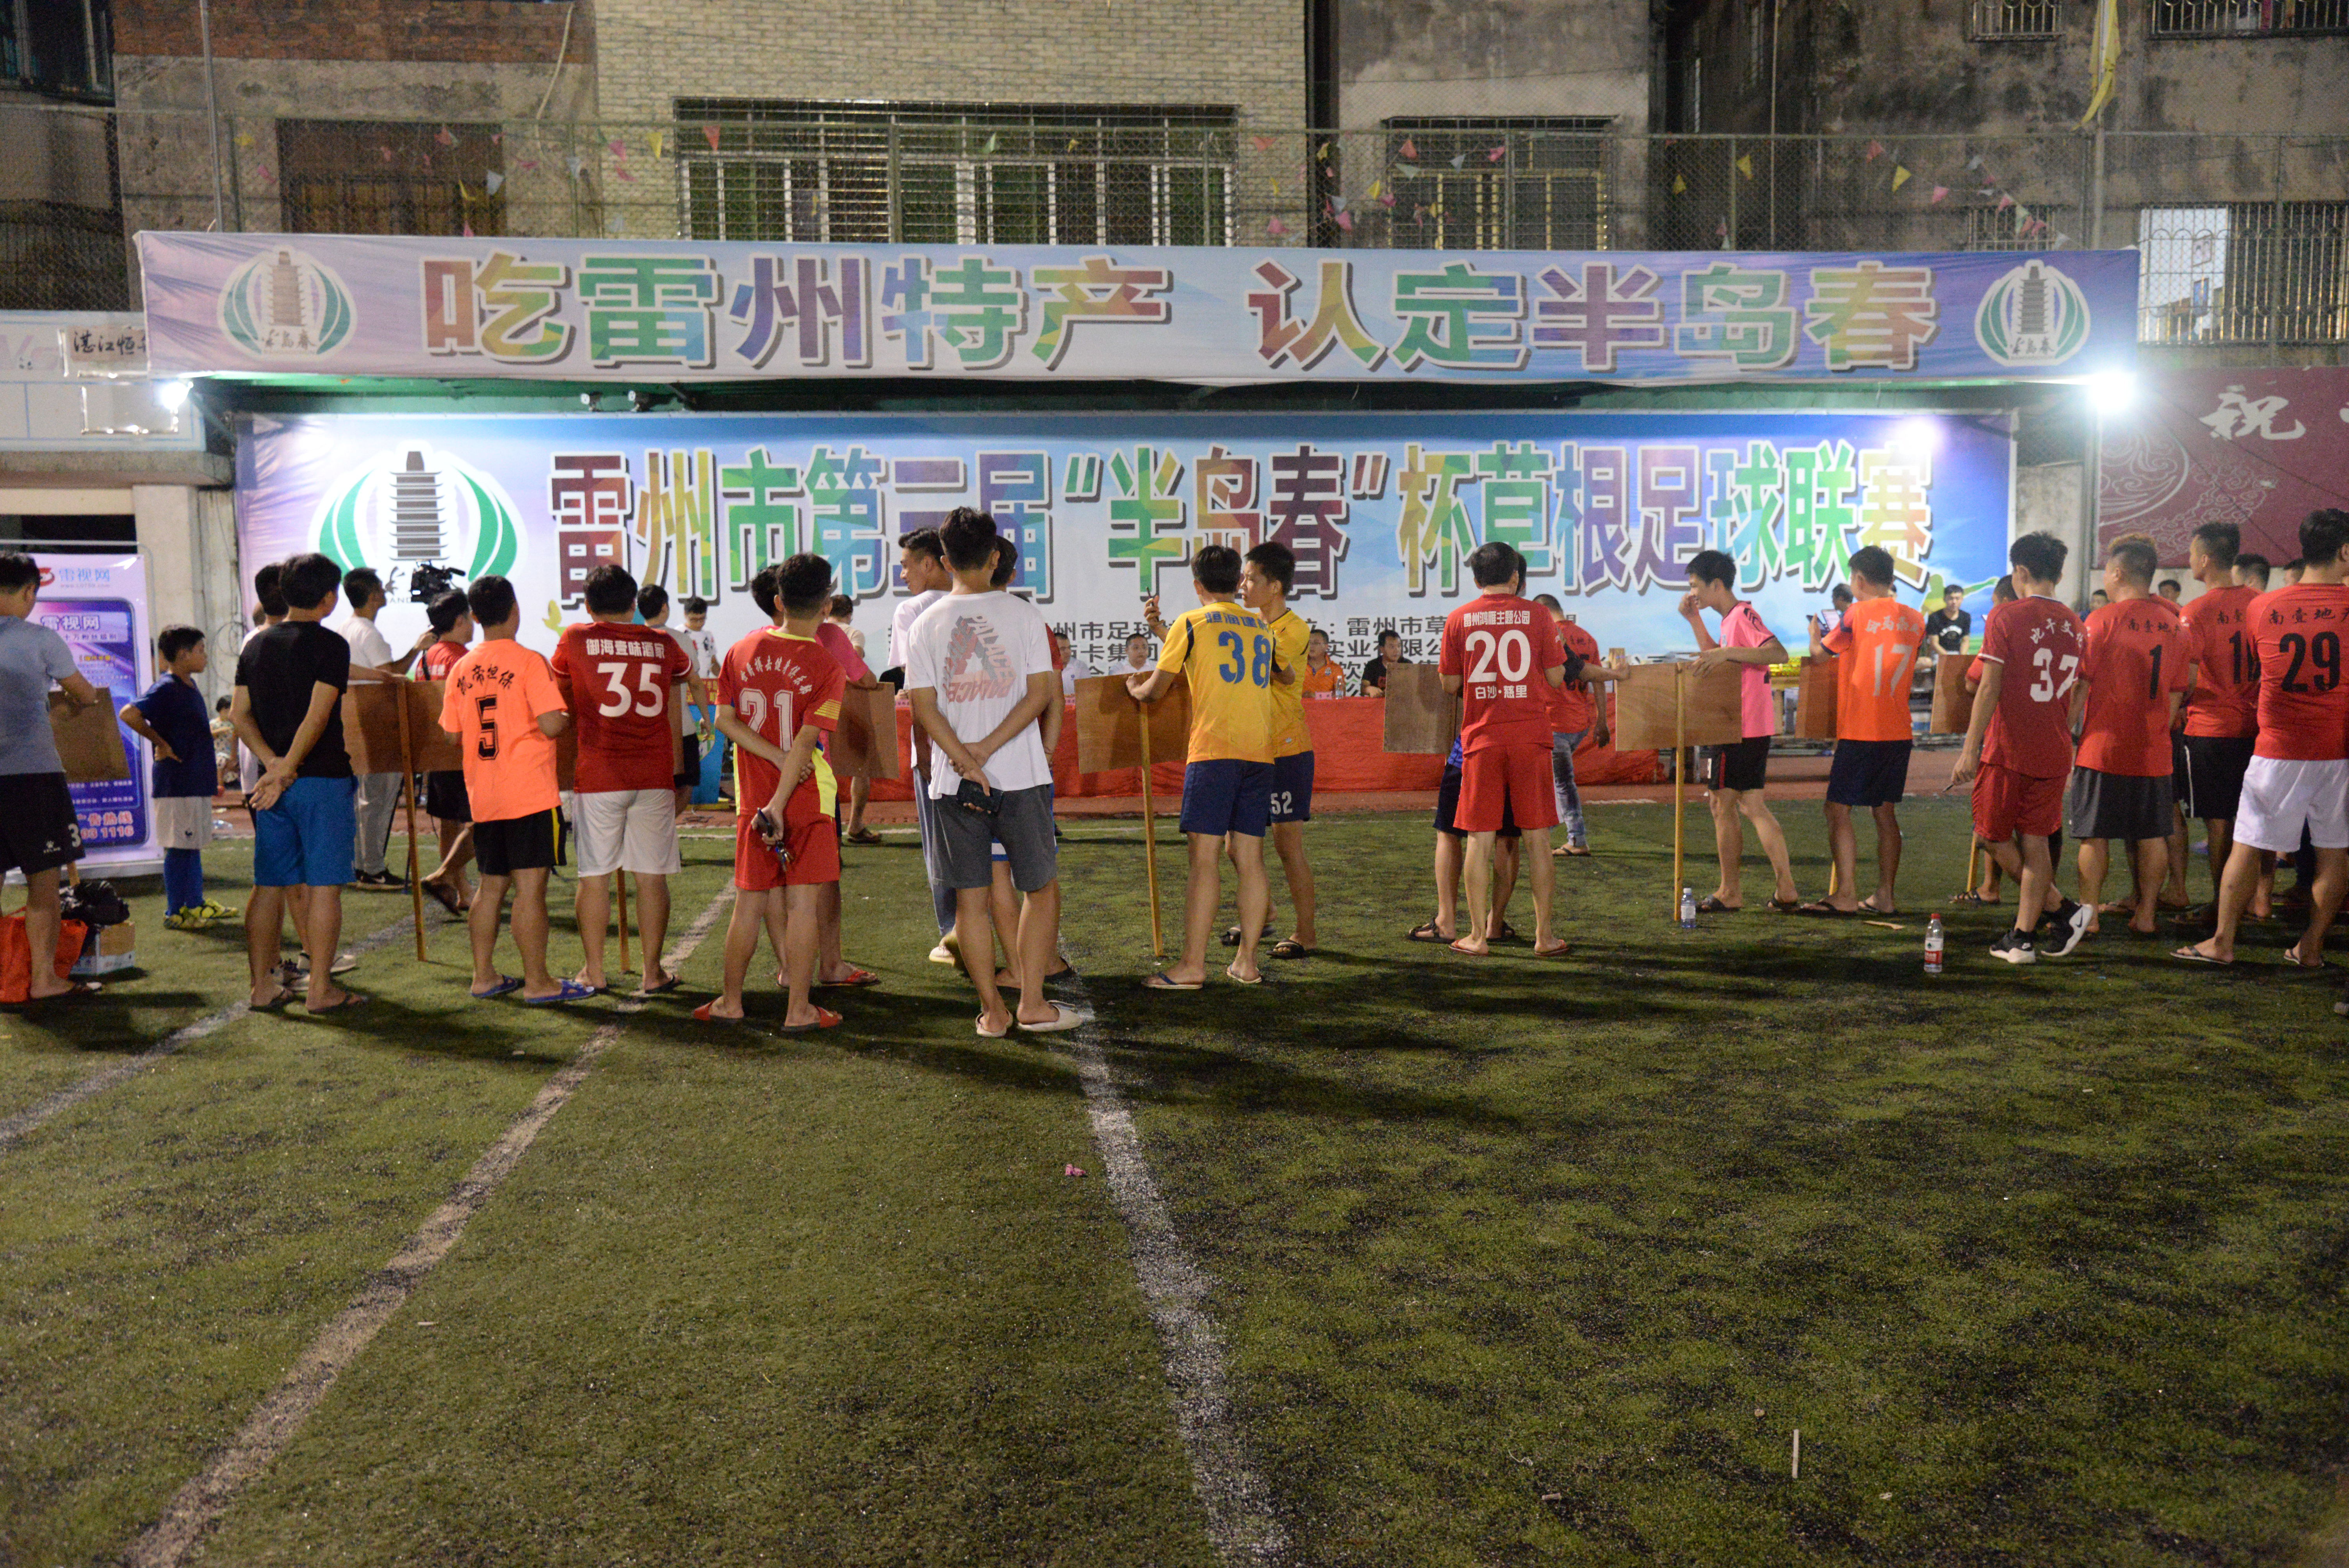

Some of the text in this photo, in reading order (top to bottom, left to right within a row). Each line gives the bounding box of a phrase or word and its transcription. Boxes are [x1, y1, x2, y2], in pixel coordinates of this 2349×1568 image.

[419, 251, 1937, 371] 吃雷州特产 认定半岛春
[1463, 610, 1530, 627] 雷州鸿雁主题公园
[586, 638, 665, 659] 御海壹味酒家
[1219, 630, 1271, 688] 38
[1466, 629, 1531, 683] 20
[1873, 644, 1913, 697] 17
[2030, 648, 2079, 702] 37
[2149, 645, 2162, 699] 1
[2279, 631, 2341, 693] 29
[597, 663, 663, 718] 35
[475, 694, 499, 761] 5
[739, 688, 793, 752] 21
[1271, 791, 1293, 814] 52
